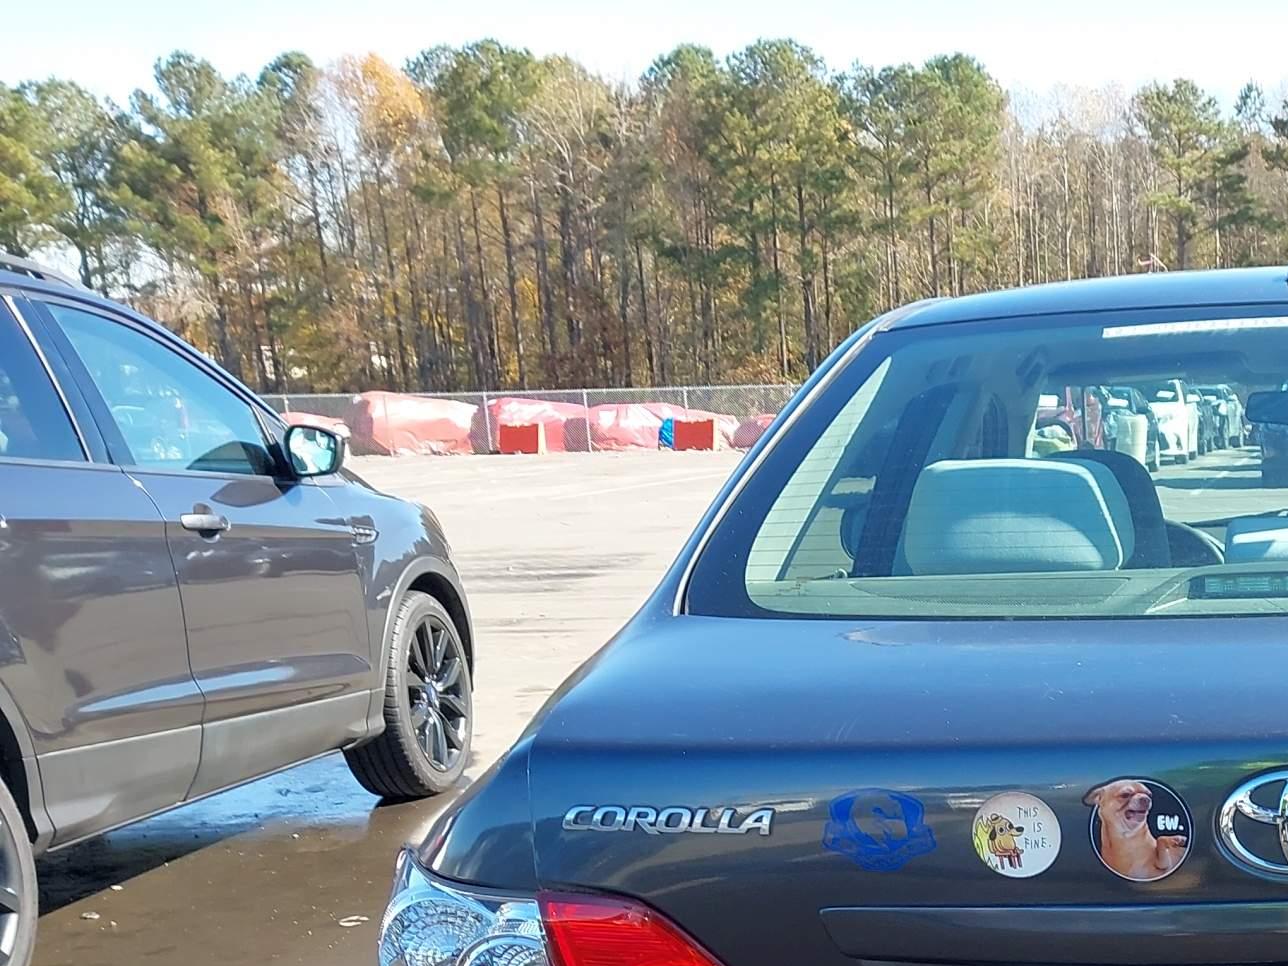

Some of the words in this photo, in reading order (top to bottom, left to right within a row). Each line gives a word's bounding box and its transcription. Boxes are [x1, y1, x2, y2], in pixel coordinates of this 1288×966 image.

[1017, 806, 1039, 818] THIS
[562, 805, 775, 836] COROLLA
[1033, 821, 1043, 832] IS
[1157, 814, 1184, 831] EW.
[1024, 836, 1052, 849] FINE.
